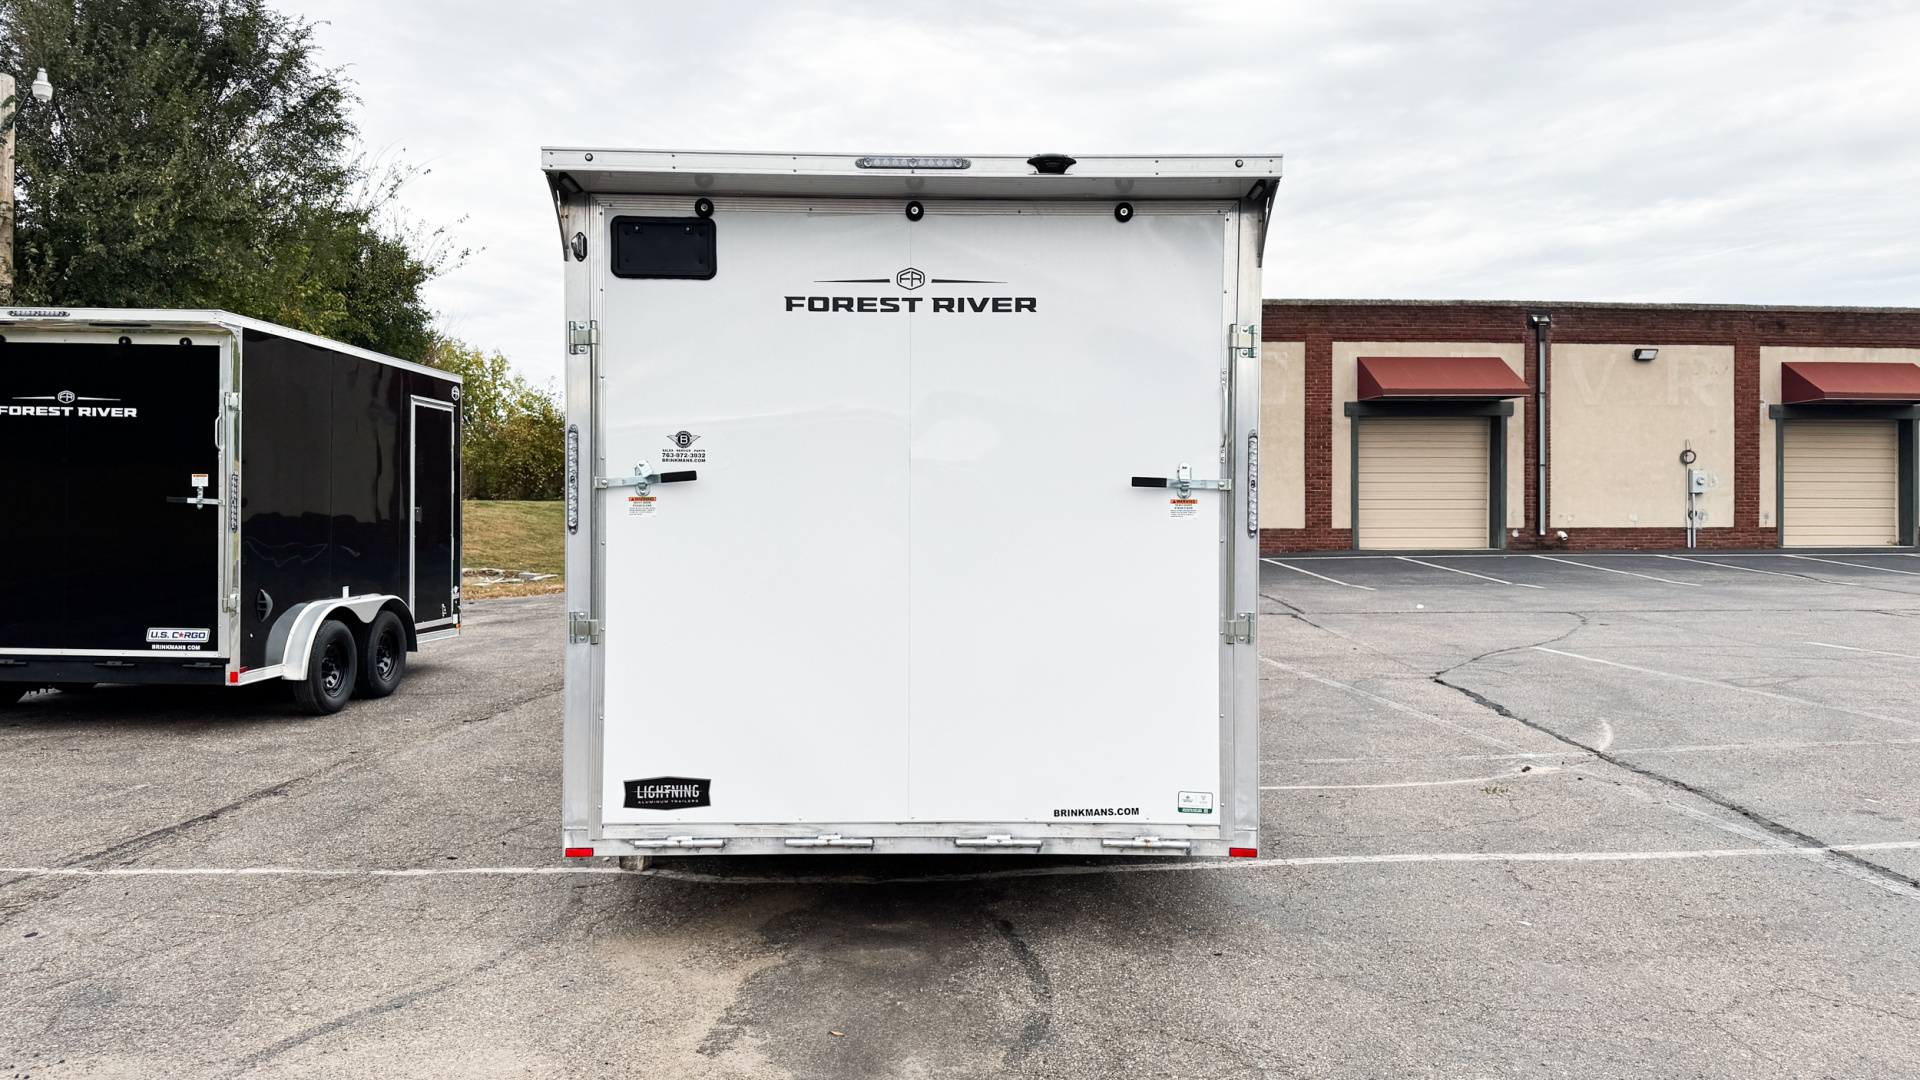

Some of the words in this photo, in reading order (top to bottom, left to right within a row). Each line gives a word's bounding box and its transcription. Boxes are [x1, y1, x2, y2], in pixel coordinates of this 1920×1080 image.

[784, 296, 923, 312] FOREST
[931, 297, 1037, 312] RIVER
[0, 406, 74, 416] FOREST
[77, 407, 137, 418] RIVER
[150, 631, 169, 639] U.S.
[637, 784, 699, 799] LIGHTNING
[1053, 807, 1140, 818] BRINKMANS.COM
